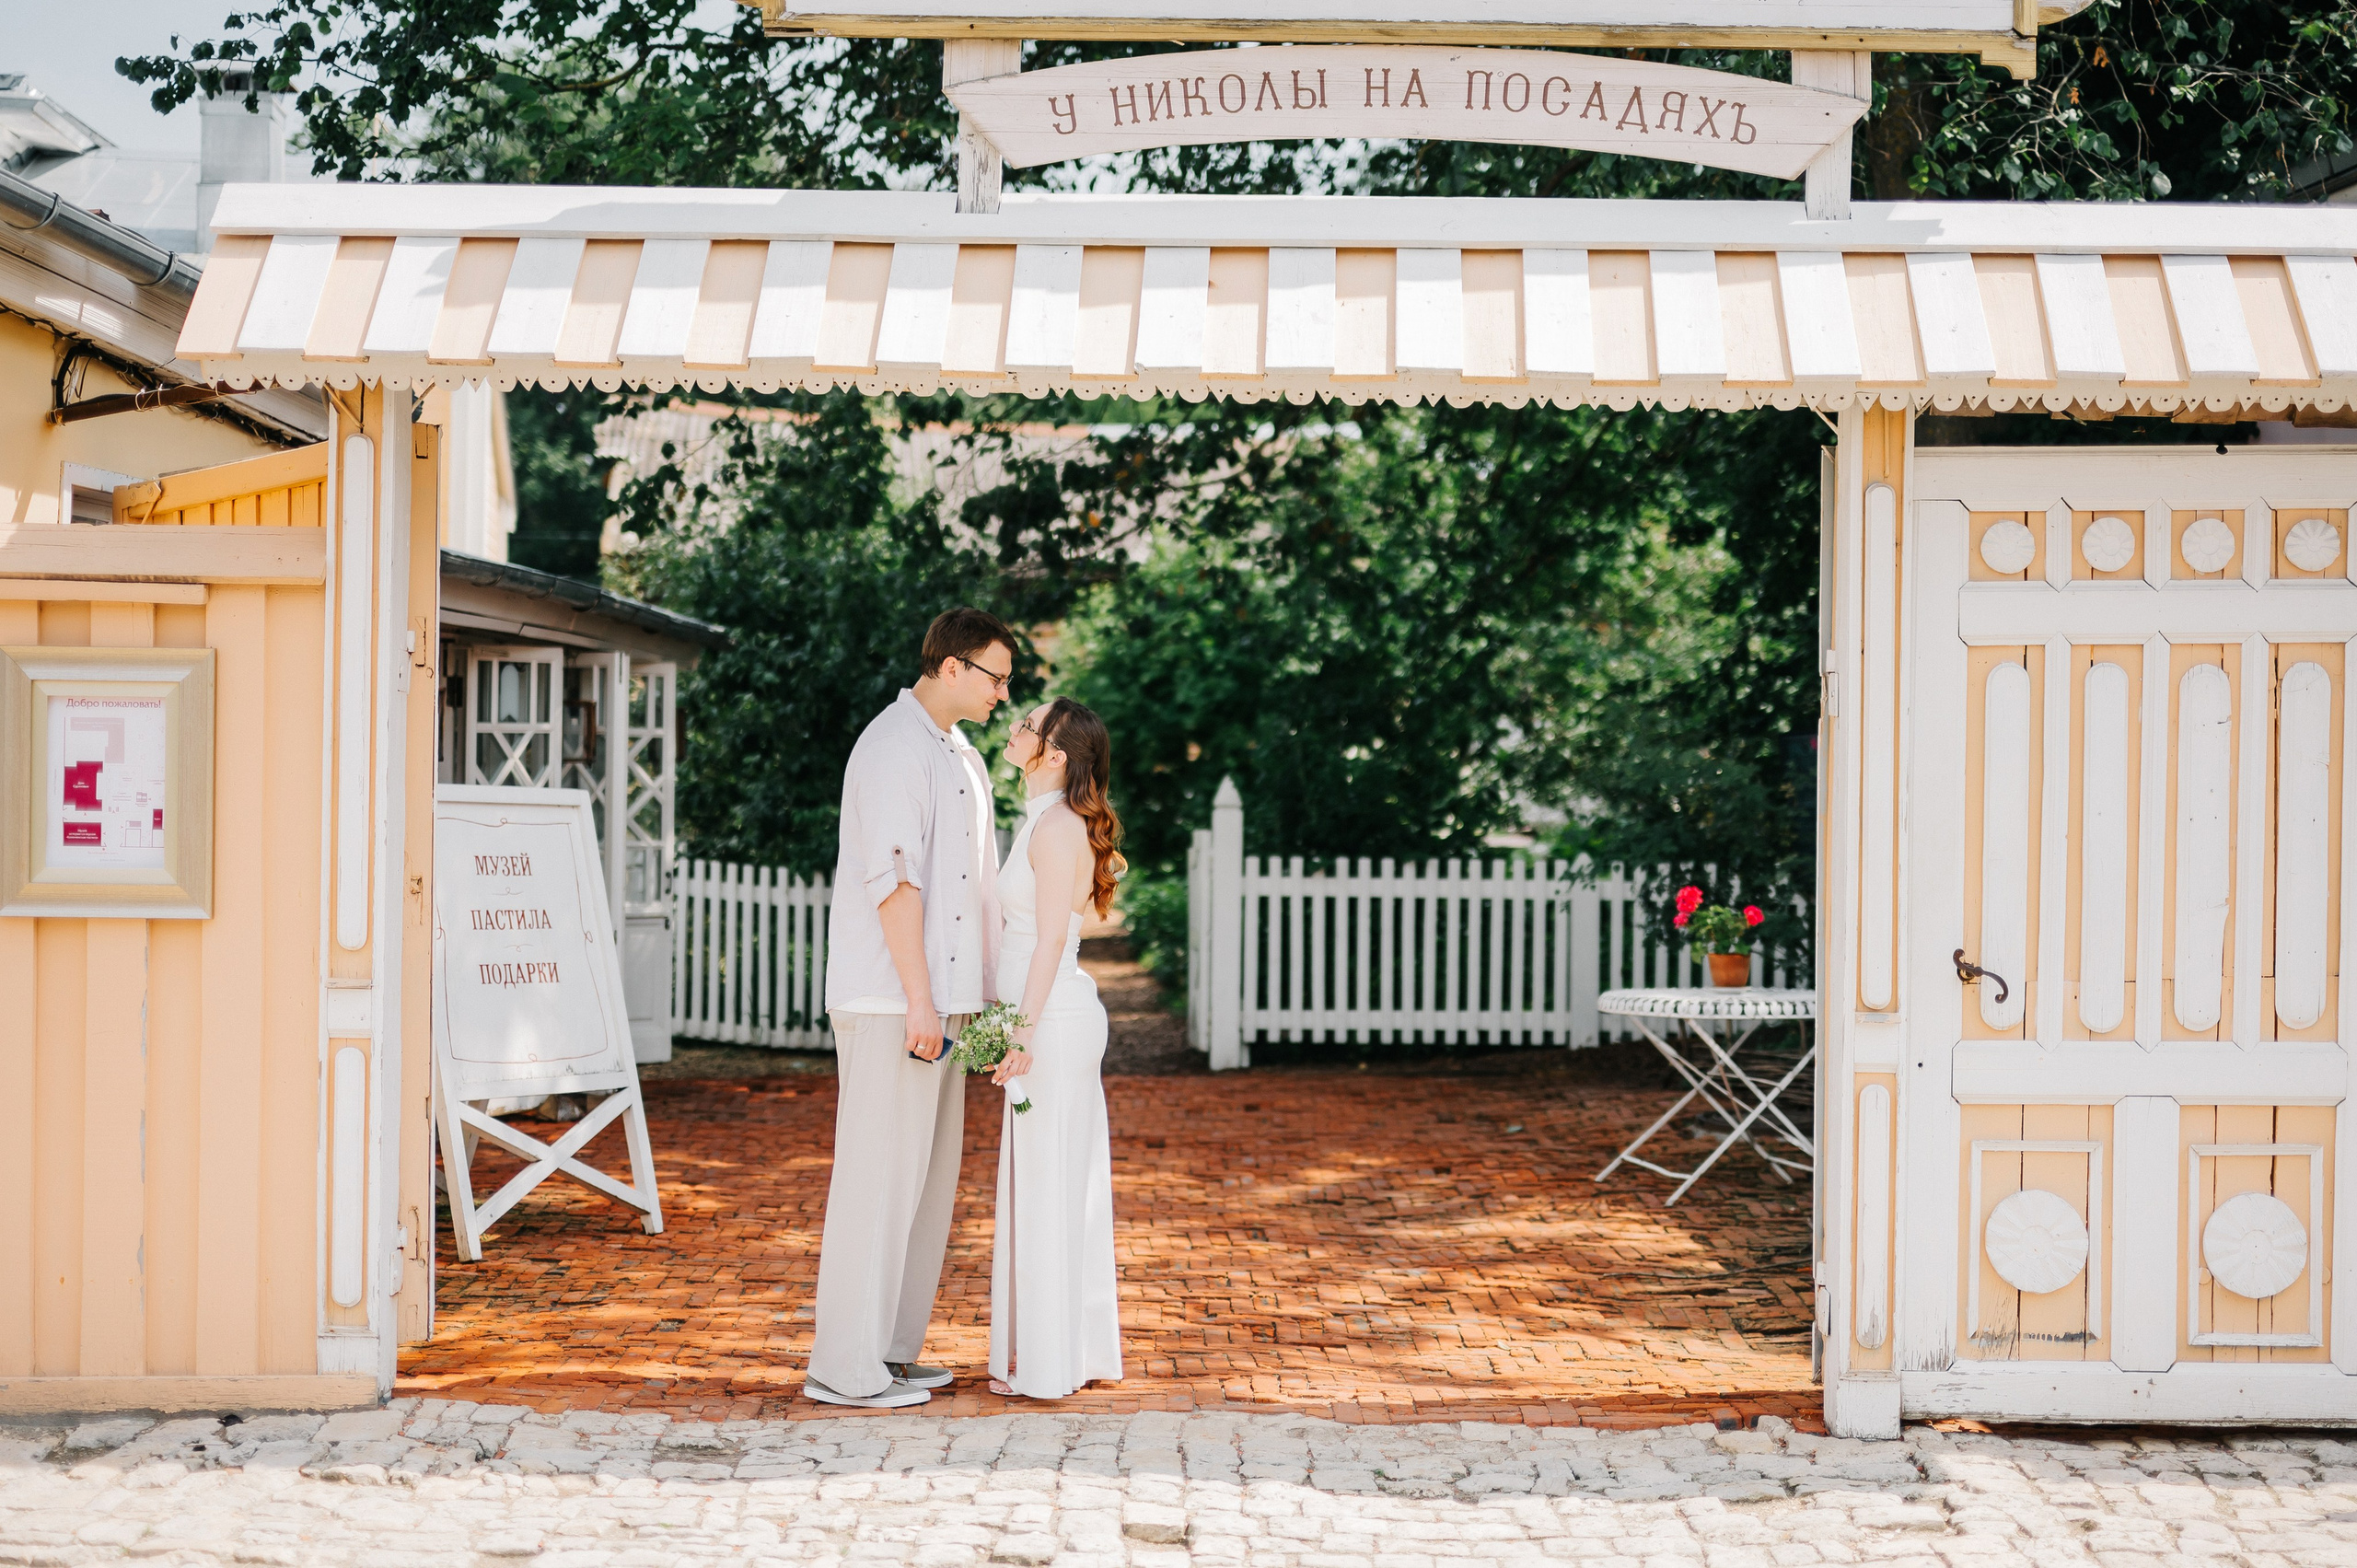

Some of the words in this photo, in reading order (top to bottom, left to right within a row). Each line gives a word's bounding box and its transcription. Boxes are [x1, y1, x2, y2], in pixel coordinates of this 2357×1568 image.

[1047, 91, 1079, 136] У
[1109, 67, 1329, 127] НИКОЛЫ
[1363, 66, 1430, 111] НА
[1465, 69, 1759, 145] ПОСАДЯХЪ
[65, 698, 99, 709] Добро
[101, 700, 162, 709] пожаловать!
[473, 853, 533, 877] МУЗЕЙ
[470, 909, 553, 931] ПАСТИЛА
[478, 962, 561, 989] ПОДАРКИ
